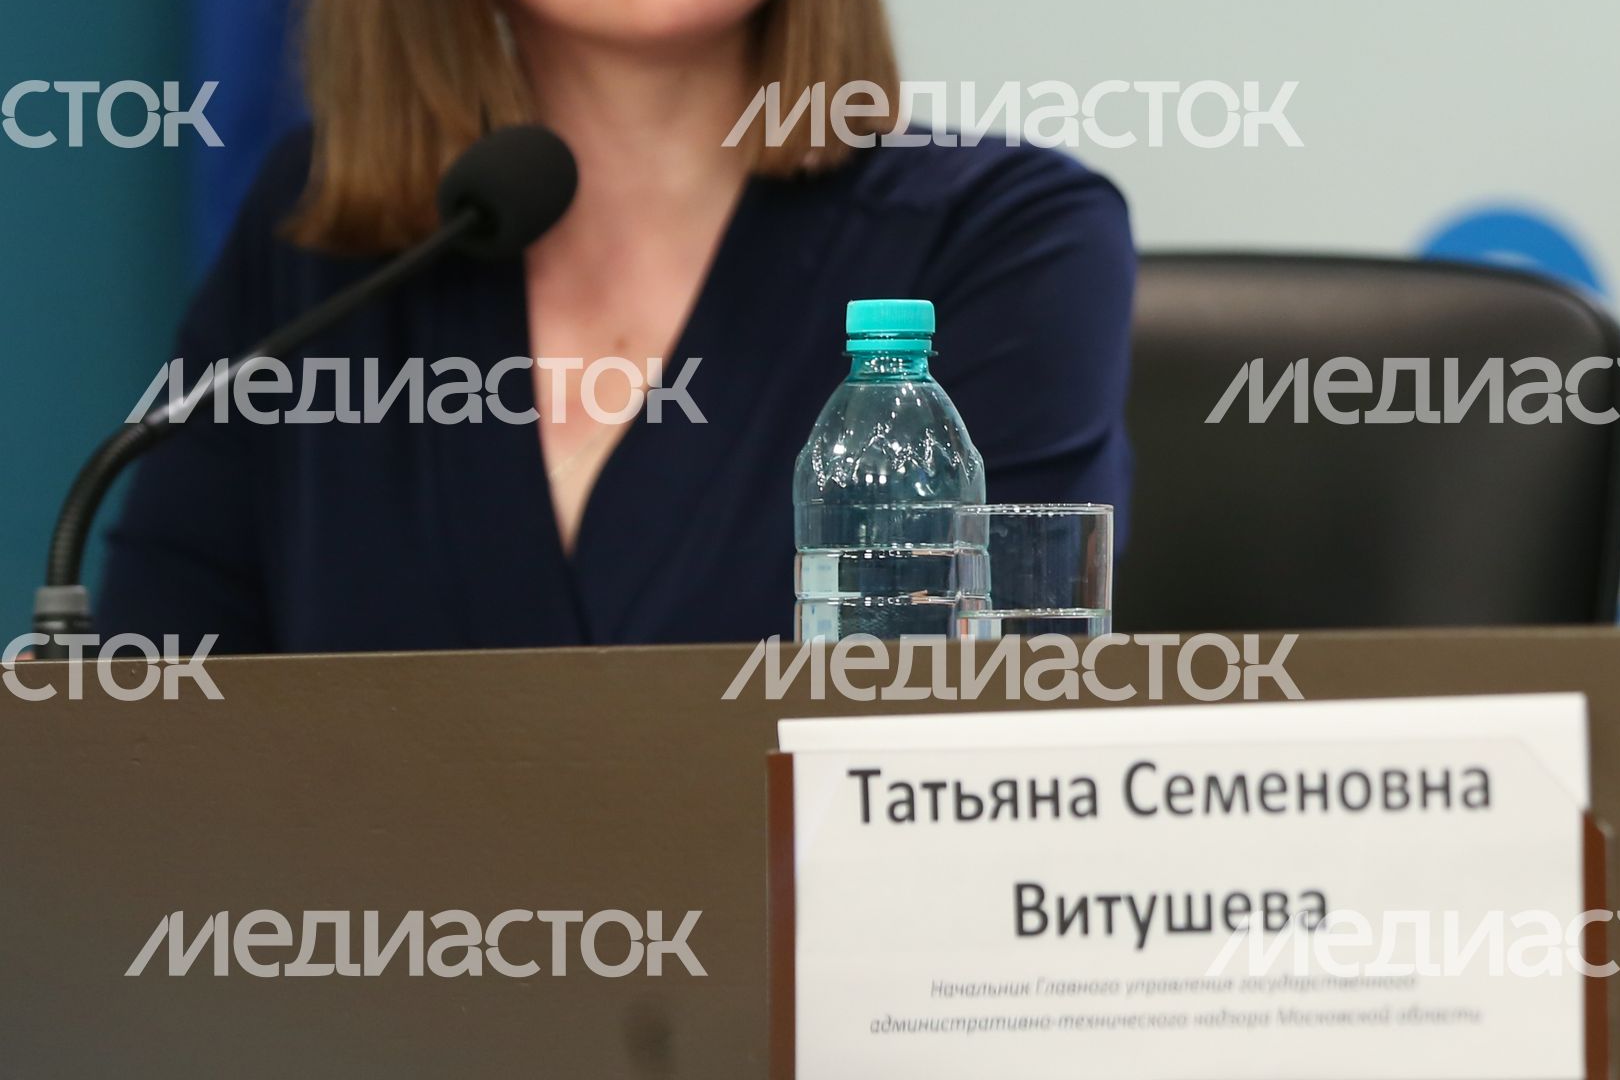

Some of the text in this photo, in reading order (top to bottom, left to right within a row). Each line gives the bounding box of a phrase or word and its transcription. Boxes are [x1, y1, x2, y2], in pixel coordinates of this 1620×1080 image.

[847, 760, 1493, 825] Татьяна Семеновна
[1012, 882, 1330, 951] Витушева
